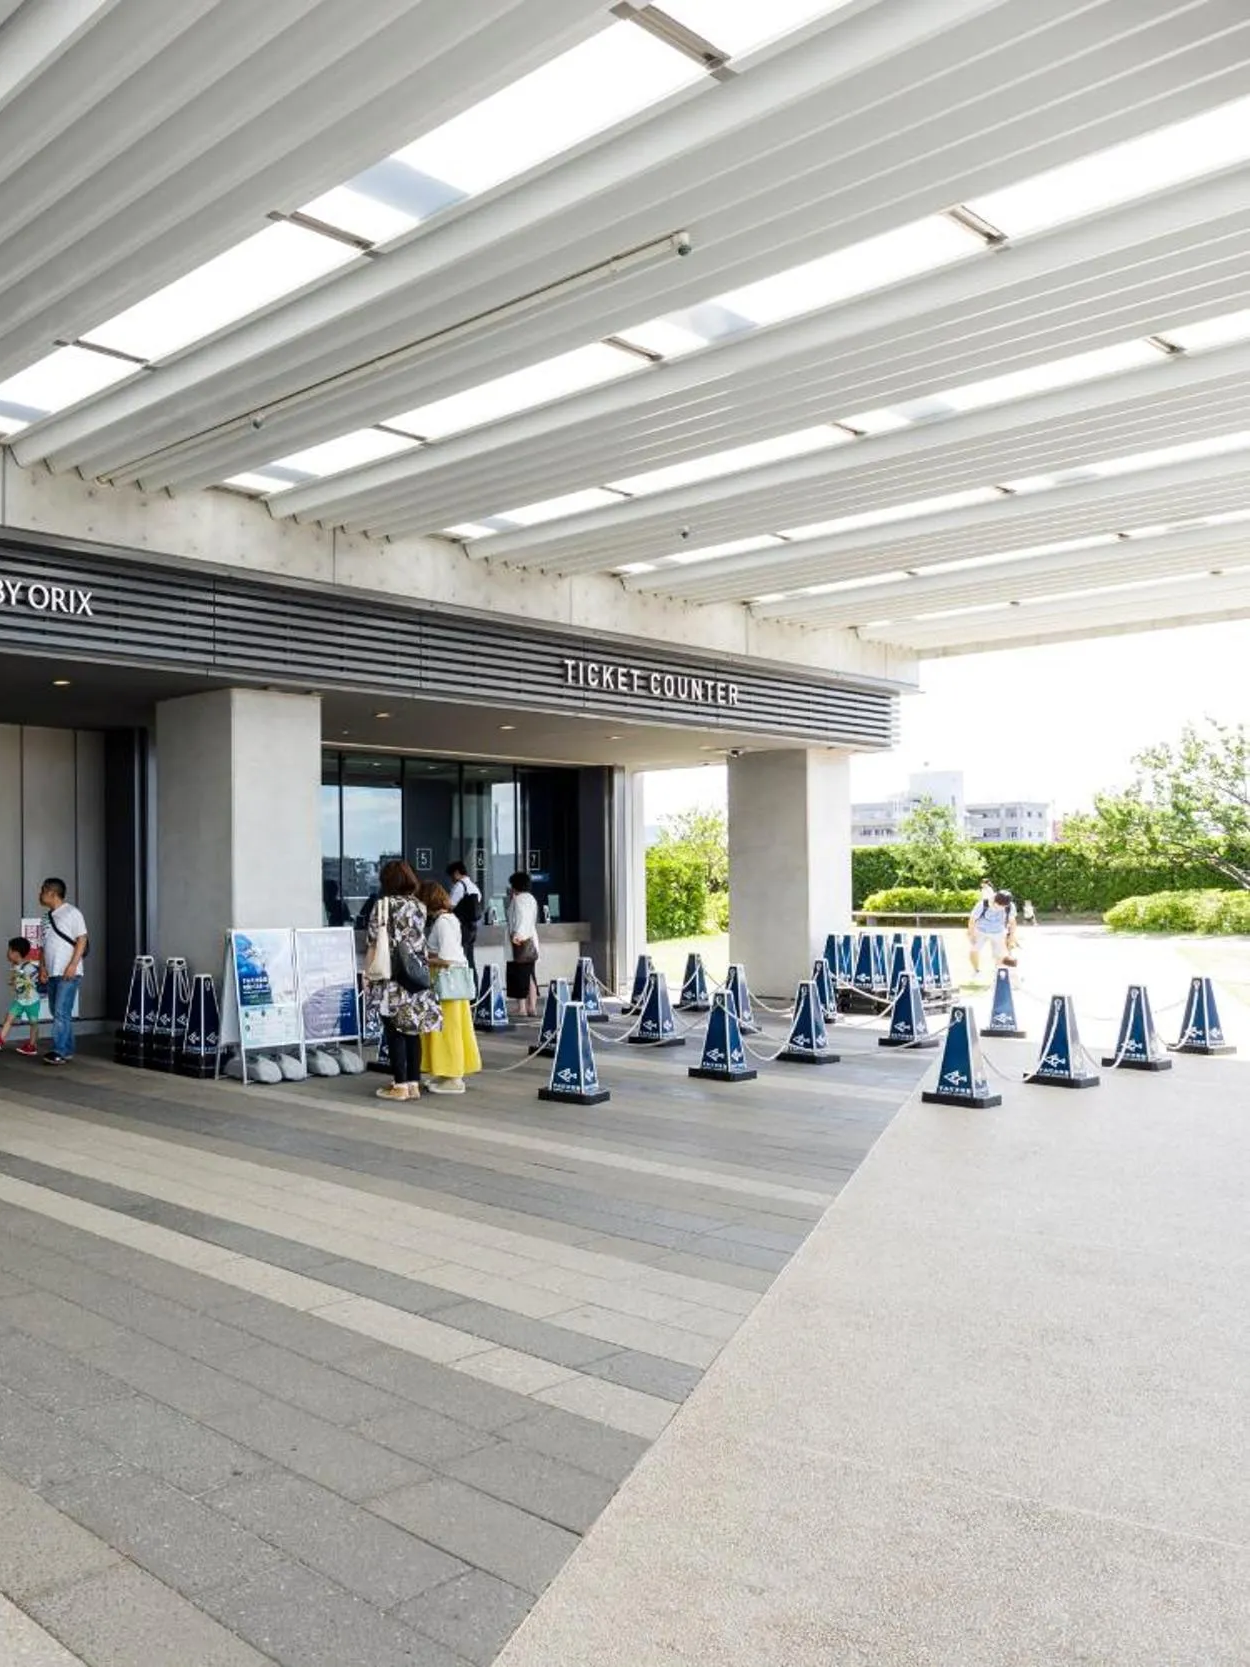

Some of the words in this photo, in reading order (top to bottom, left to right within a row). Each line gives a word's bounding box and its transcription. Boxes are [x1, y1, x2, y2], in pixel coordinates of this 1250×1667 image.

[28, 584, 93, 616] ORIX
[564, 659, 641, 693] TICKET
[651, 672, 739, 705] COUNTER
